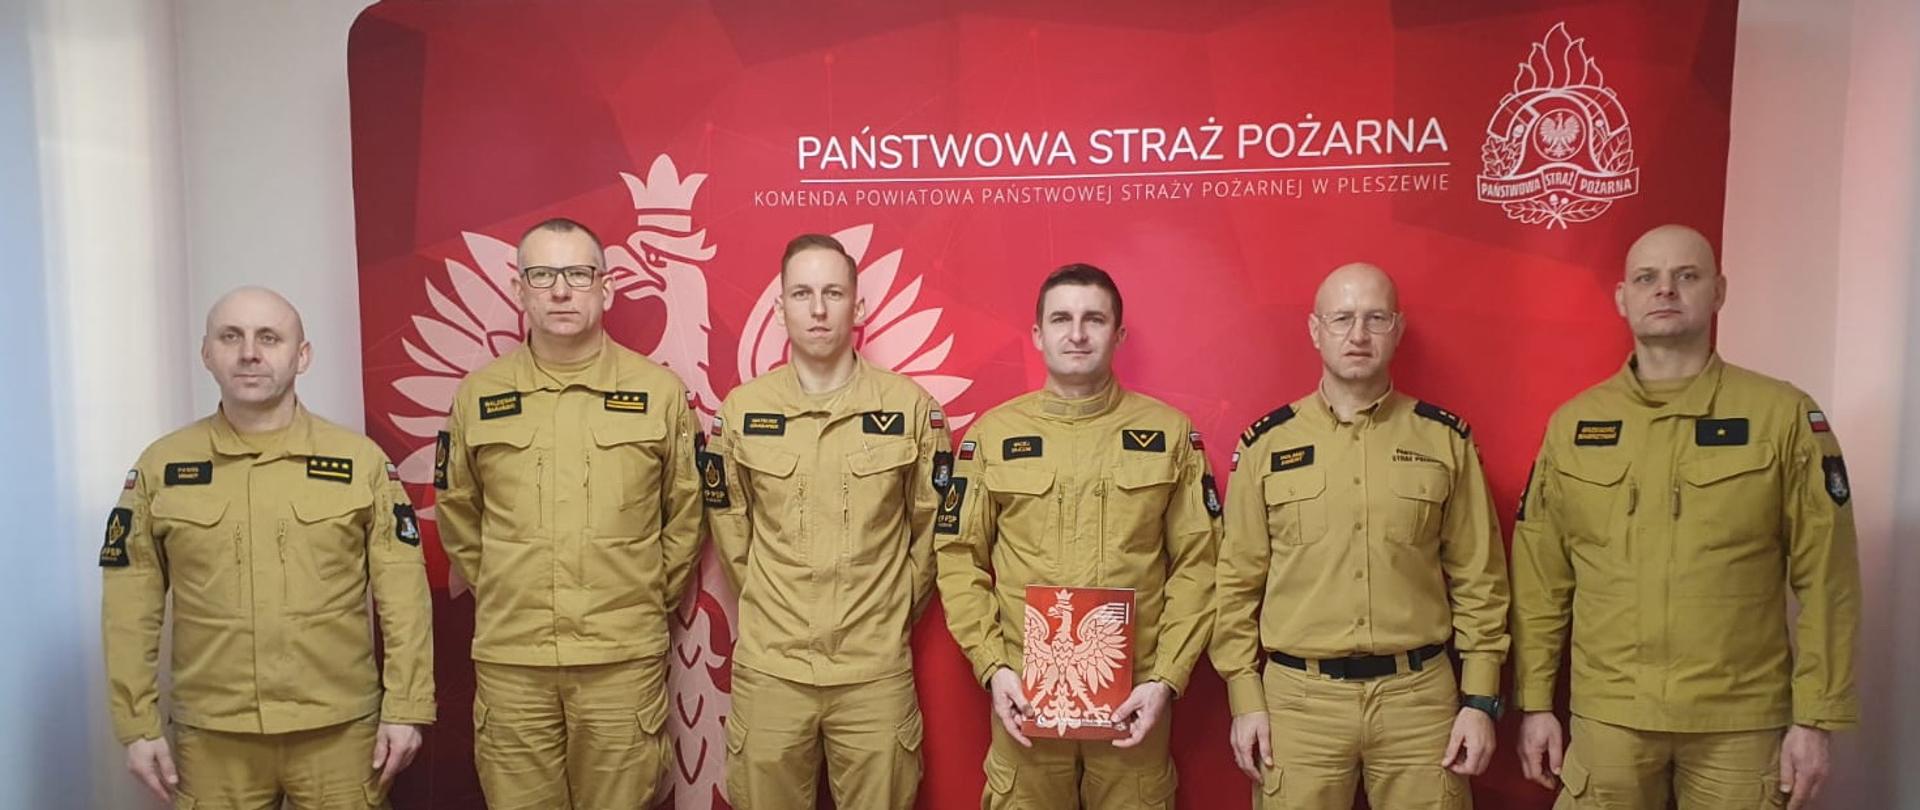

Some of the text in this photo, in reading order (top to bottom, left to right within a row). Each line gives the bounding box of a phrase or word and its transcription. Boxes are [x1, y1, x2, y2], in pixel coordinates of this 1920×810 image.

[798, 112, 1449, 171] PAŃSTWOWA STRAŻ POŻARNA
[754, 173, 1449, 207] KOMENDA POWIATOWA PAŃSTWOWEJ STRAŻY POŻARNEJ W PLESZEWIE
[1480, 171, 1633, 198] PAŃSTWOWA STRAŻ POŻARNA
